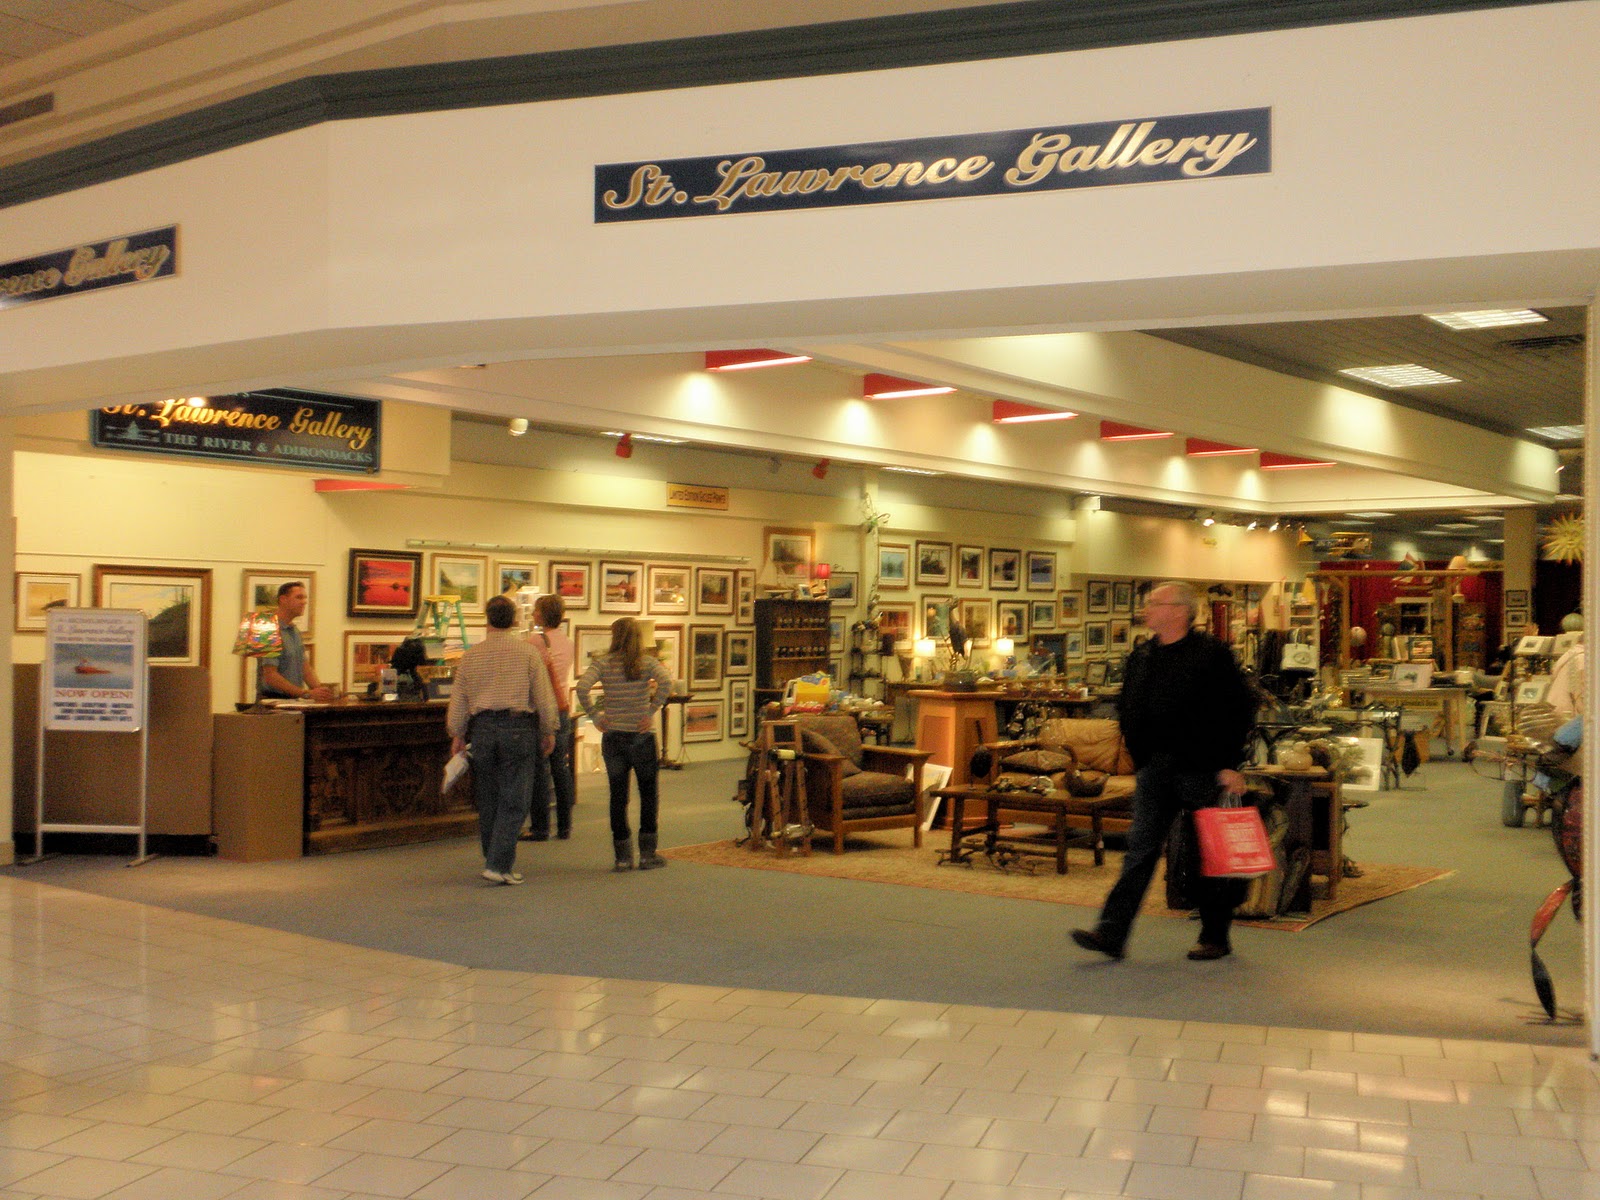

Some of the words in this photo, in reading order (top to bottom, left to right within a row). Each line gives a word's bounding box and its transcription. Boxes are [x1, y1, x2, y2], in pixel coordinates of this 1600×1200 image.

[604, 164, 688, 209] St.
[694, 154, 995, 210] Lawrence
[1004, 121, 1257, 186] Gallery
[150, 398, 281, 430] Lawrence
[289, 407, 374, 450] Gallery
[163, 432, 197, 446] THE
[203, 436, 251, 452] RIVER
[257, 443, 268, 453] &
[273, 444, 373, 463] ADIRONDACKS
[56, 690, 88, 698] NOW
